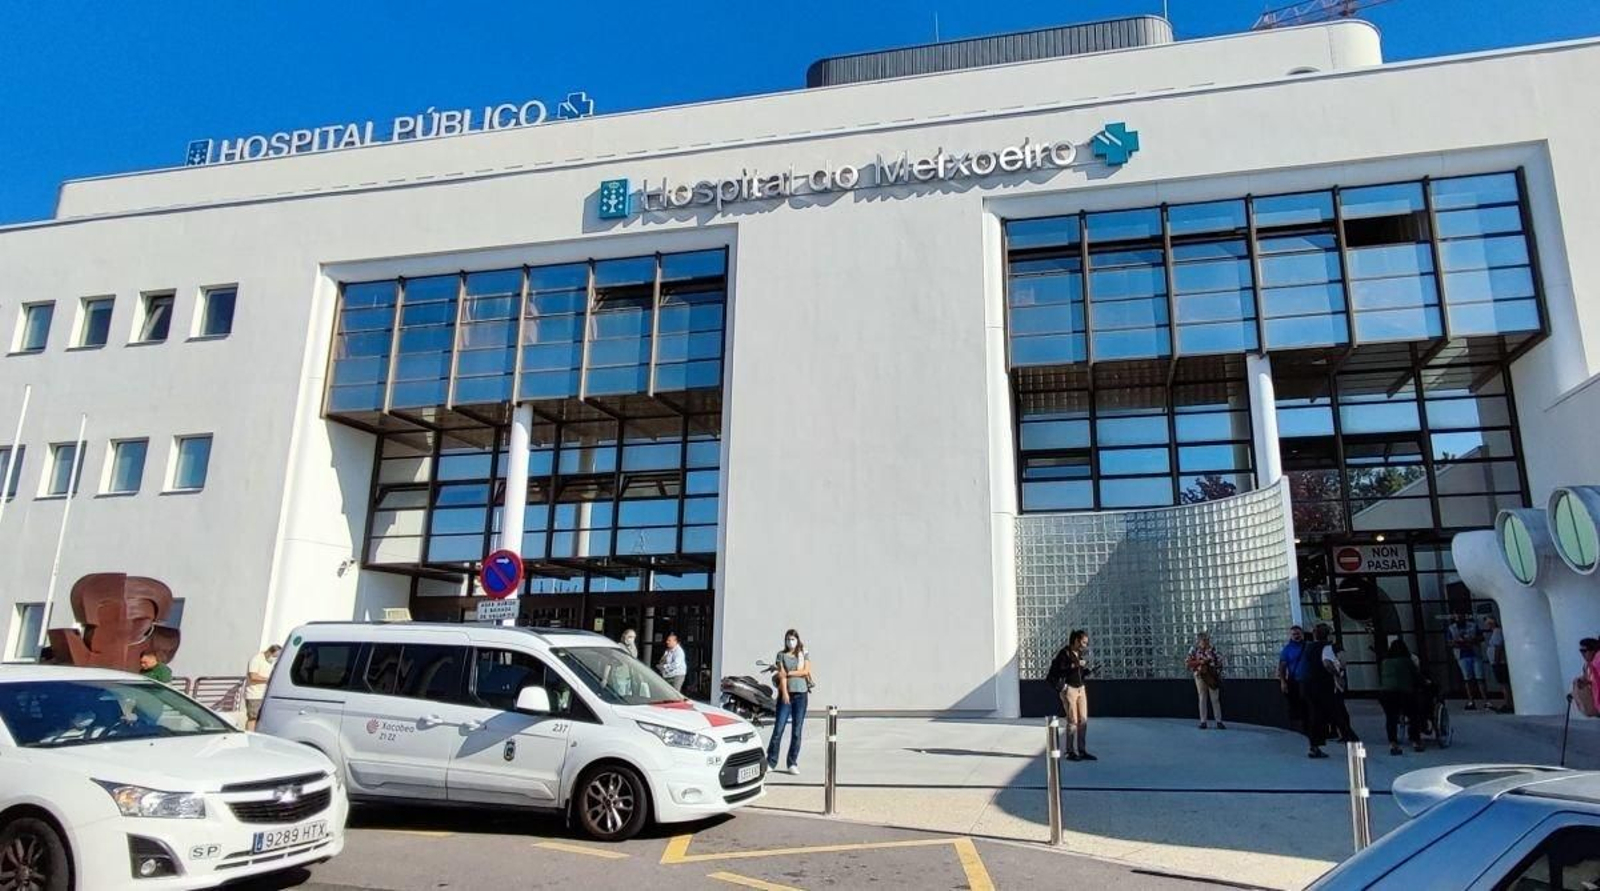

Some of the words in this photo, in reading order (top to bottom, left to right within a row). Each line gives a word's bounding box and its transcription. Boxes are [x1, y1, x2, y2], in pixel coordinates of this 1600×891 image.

[219, 121, 382, 164] HOSPITAL
[392, 100, 547, 142] PÚBLICO
[641, 163, 795, 211] Hospital
[808, 160, 859, 191] do
[875, 136, 1077, 185] Meixoeiro
[1367, 559, 1407, 570] PASAR
[1371, 546, 1399, 557] NON
[265, 829, 300, 848] 9289
[302, 822, 328, 839] HTX
